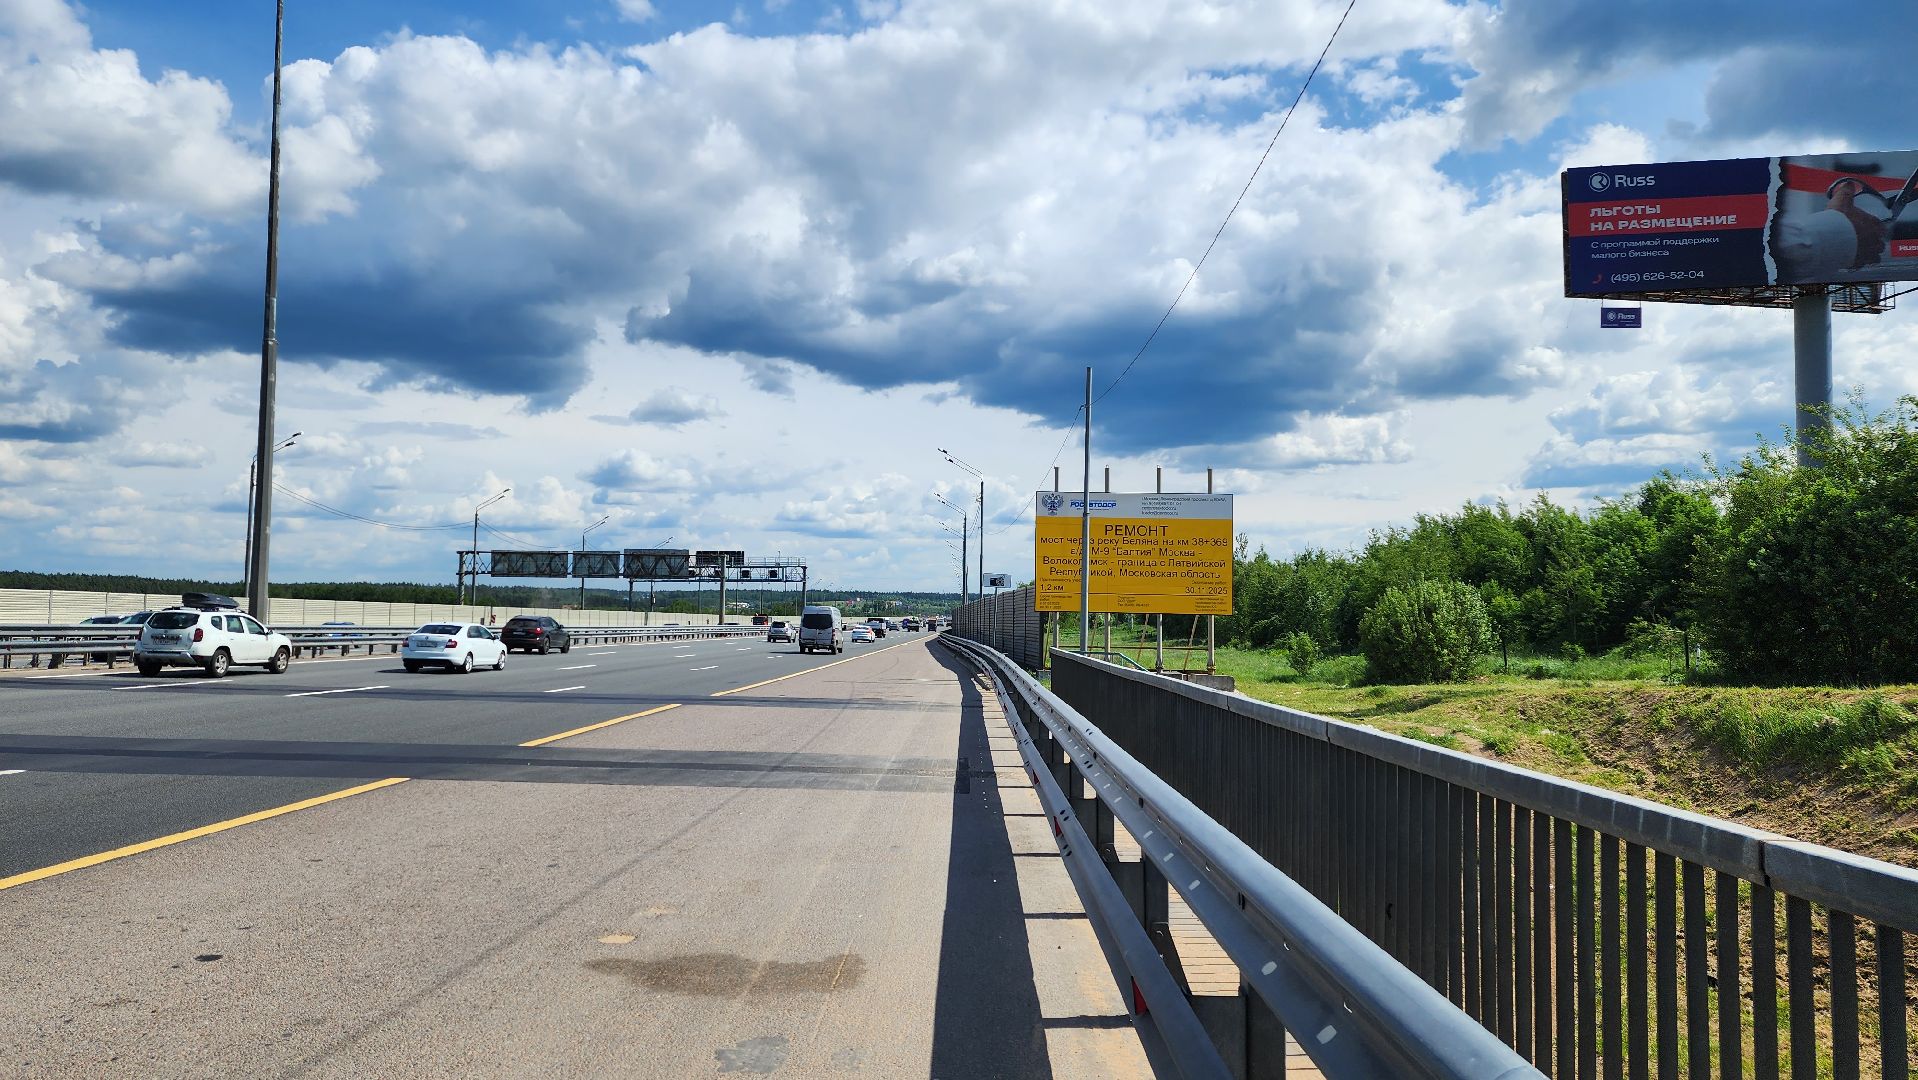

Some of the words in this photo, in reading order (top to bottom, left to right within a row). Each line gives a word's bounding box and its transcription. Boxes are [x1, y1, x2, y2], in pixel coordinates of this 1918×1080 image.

[1614, 174, 1656, 188] Russ
[1589, 204, 1661, 217] ЛЬГОТЫ
[1590, 220, 1614, 232] НА
[1618, 214, 1737, 230] РАЗМЕЩЕНИЕ
[1591, 241, 1599, 249] С
[1600, 238, 1661, 250] программой
[1663, 236, 1720, 247] поддержки
[1591, 251, 1627, 259] малого
[1628, 249, 1670, 258] бизнеса
[1611, 272, 1640, 284] (495)
[1643, 270, 1705, 281] 626-52-04
[1070, 501, 1117, 509] РОСВТОДОР
[1104, 524, 1169, 537] РЕМОНТ
[1040, 537, 1064, 545] мост
[1067, 537, 1095, 546] черз
[1097, 538, 1120, 547] реку
[1122, 537, 1159, 546] Беляна
[1191, 537, 1229, 547] 38+369
[1091, 547, 1110, 556] М-9
[1159, 548, 1195, 557] Москва
[1043, 556, 1108, 566] Волоколмск
[1117, 559, 1157, 569] граница
[1168, 559, 1226, 568] Латвийской
[1049, 567, 1116, 578] Респубикой,
[1119, 568, 1178, 578] Московская
[1180, 569, 1221, 579] область
